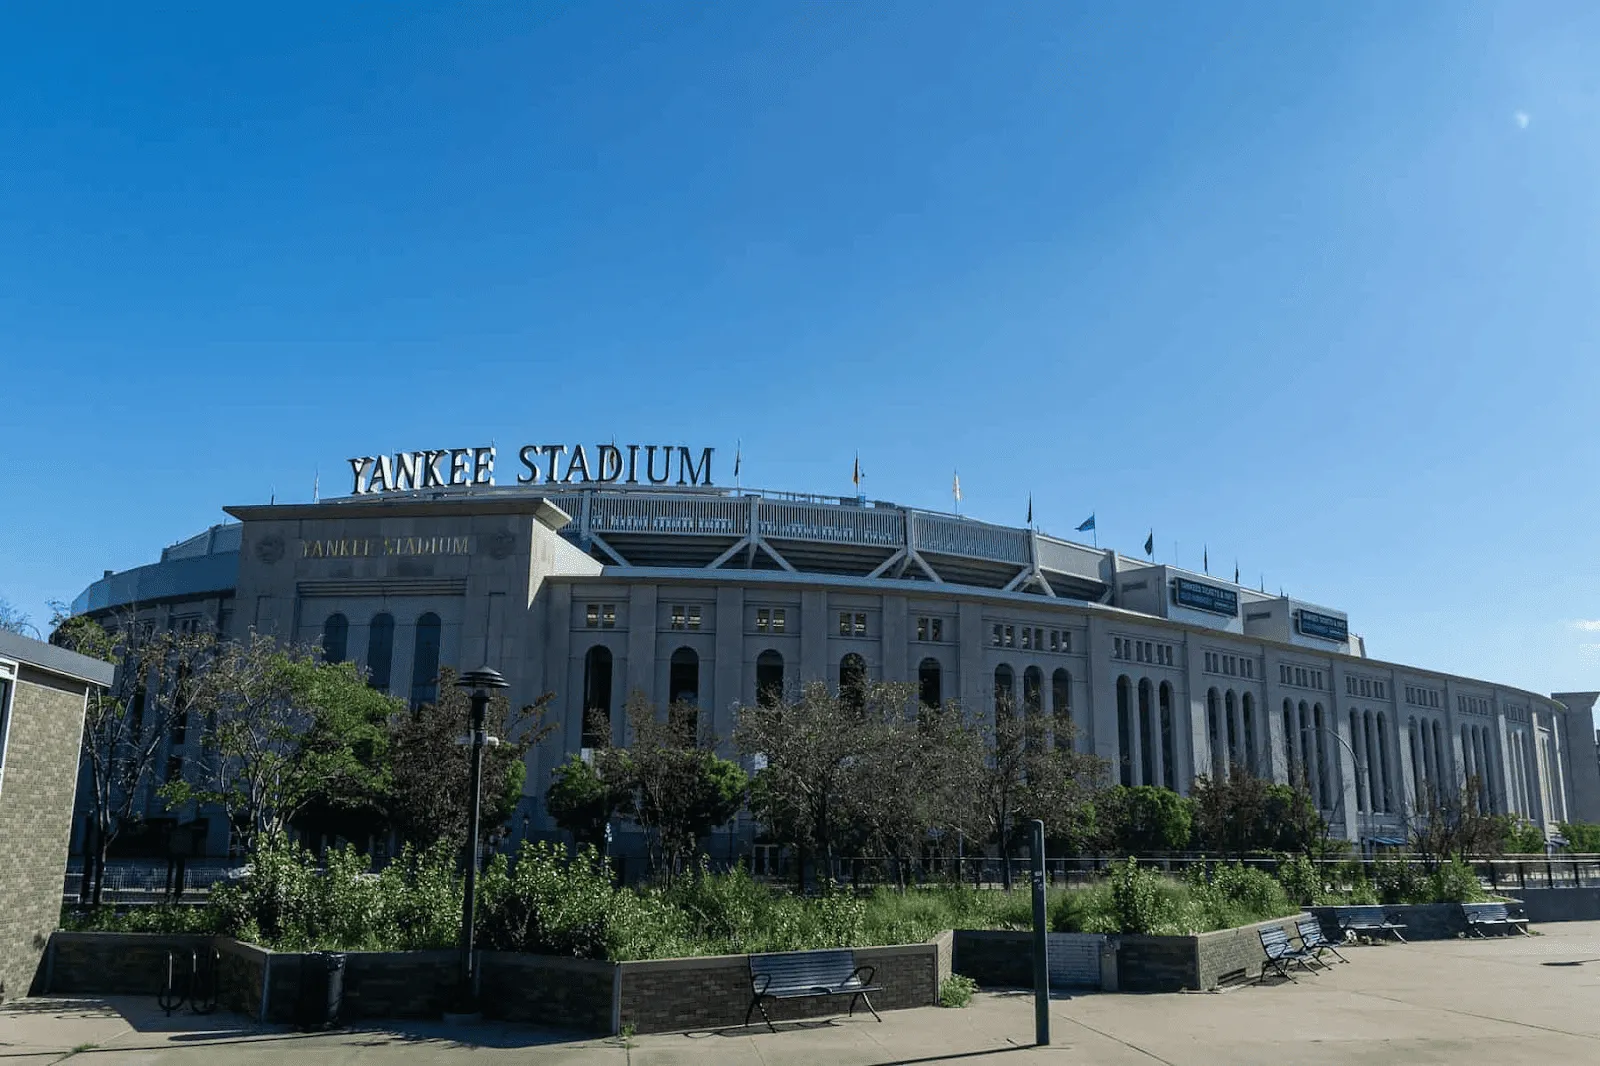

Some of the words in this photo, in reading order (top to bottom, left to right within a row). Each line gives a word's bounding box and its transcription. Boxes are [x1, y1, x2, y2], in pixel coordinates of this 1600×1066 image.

[347, 447, 496, 495] YANKEE
[517, 444, 715, 486] STADIUM
[383, 536, 469, 556] STADIUM
